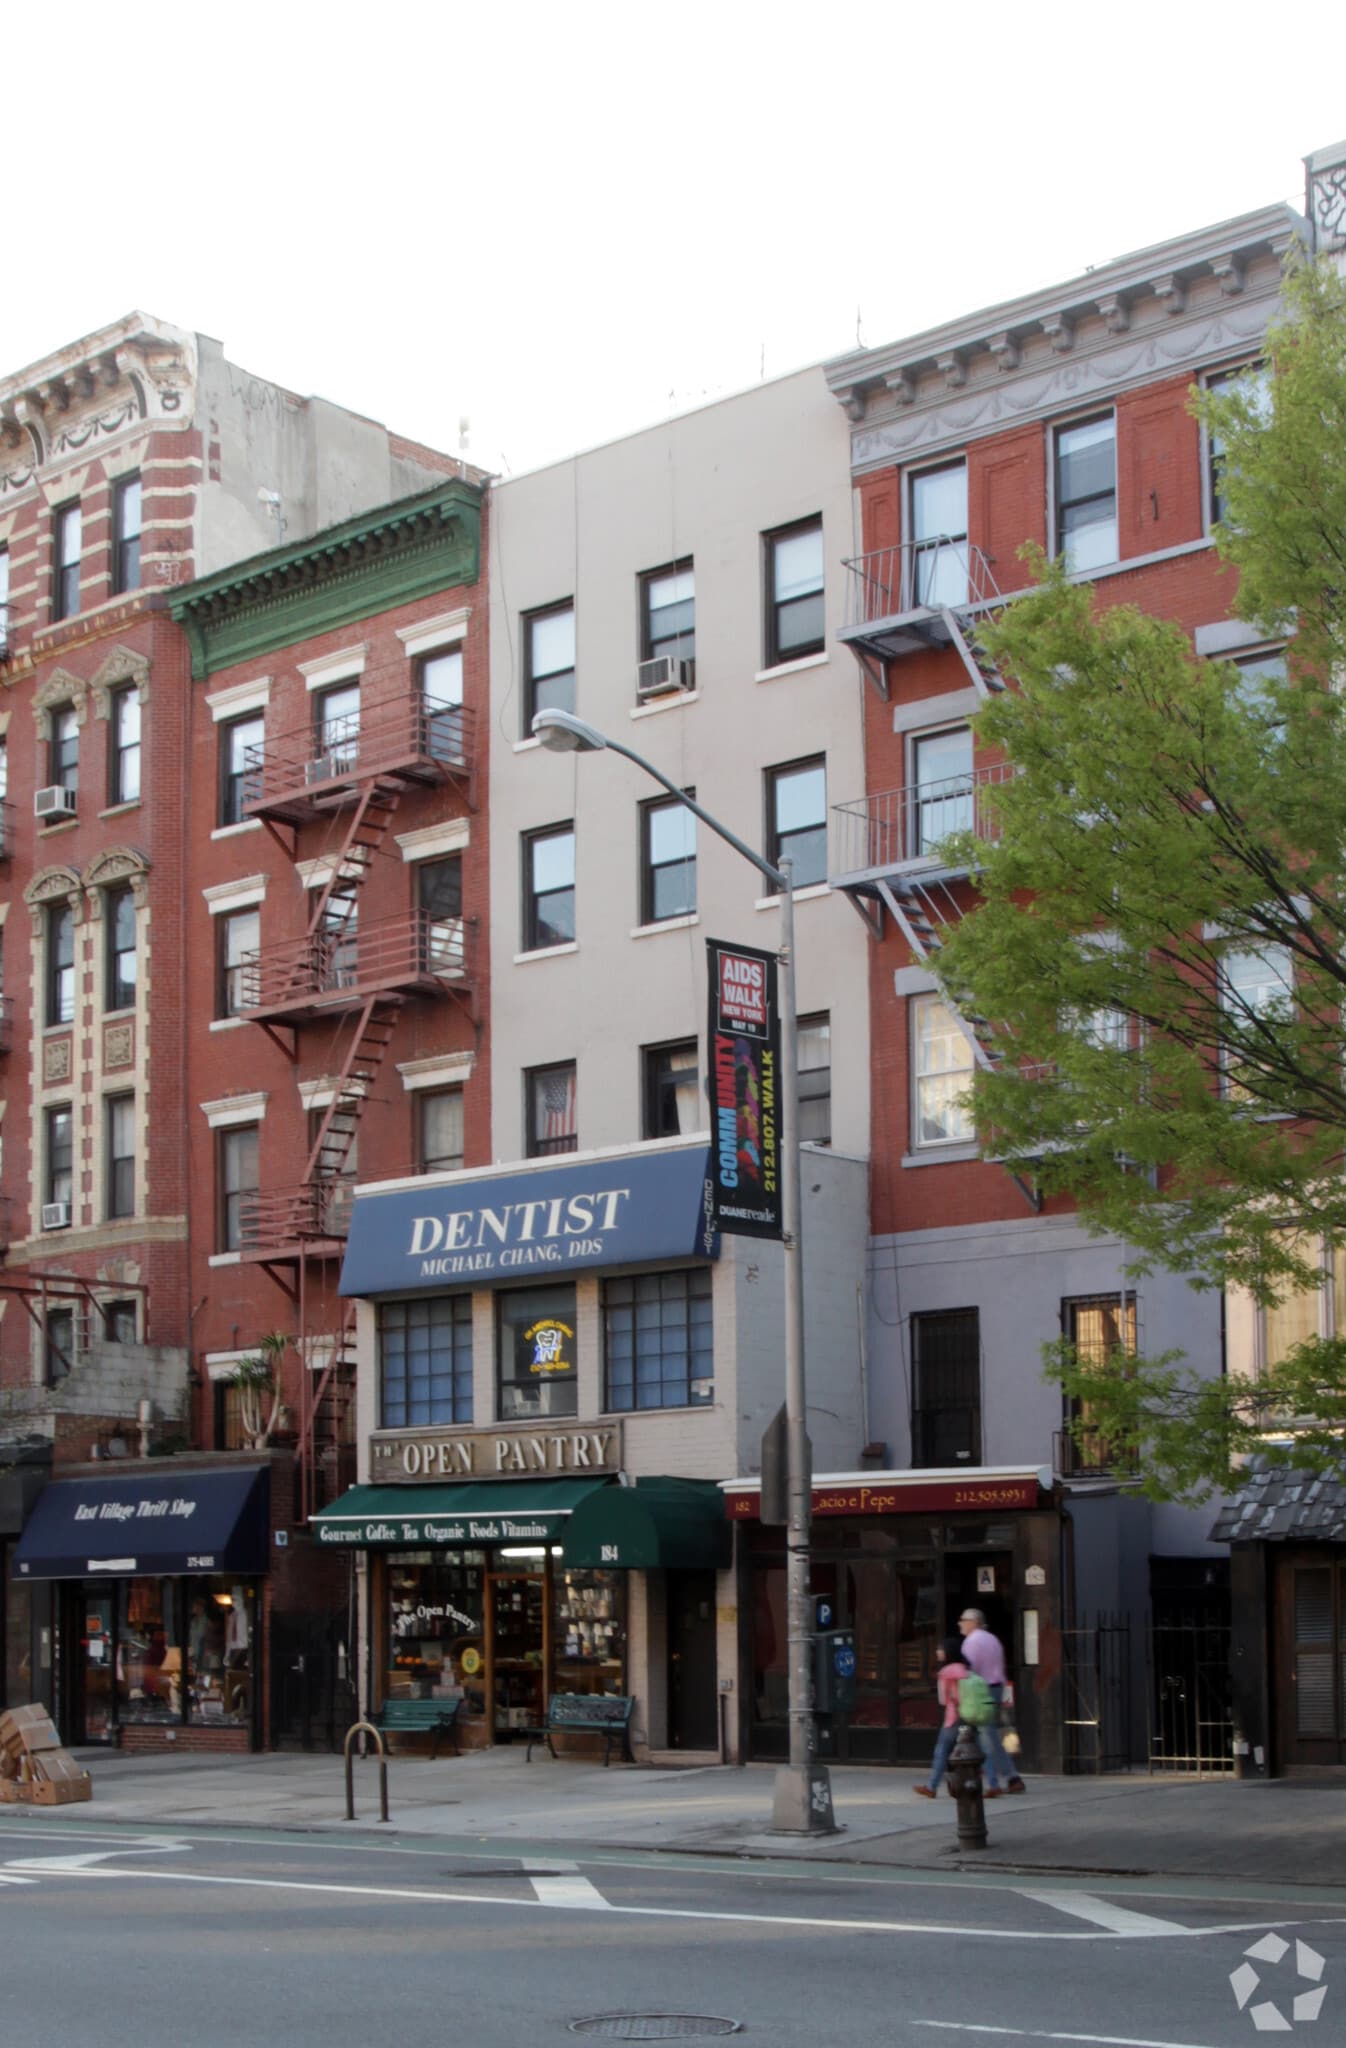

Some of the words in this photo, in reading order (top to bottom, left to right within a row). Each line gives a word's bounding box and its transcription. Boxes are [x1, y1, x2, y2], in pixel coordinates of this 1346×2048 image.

[723, 958, 762, 988] AIDS
[723, 983, 763, 1009] WALK
[721, 1003, 741, 1016] NEW
[742, 1007, 764, 1021] YORK
[714, 1032, 738, 1190] COMMUNITY
[407, 1189, 631, 1256] DENTIST
[420, 1251, 494, 1277] MICHAEL
[500, 1244, 563, 1267] CHANG,
[568, 1238, 604, 1258] DDS
[403, 1442, 473, 1475] OPEN
[495, 1432, 612, 1472] PANTRY
[74, 1504, 98, 1520] East
[99, 1502, 135, 1522] Village
[136, 1500, 169, 1518] Thrift
[169, 1499, 196, 1519] Shop
[849, 1498, 858, 1508] e
[860, 1488, 896, 1513] Pepe
[320, 1526, 362, 1541] Gourmet
[366, 1523, 396, 1540] Coffee
[401, 1523, 419, 1540] Tea
[424, 1522, 464, 1542] Organic
[469, 1521, 499, 1539] Foods
[501, 1520, 549, 1538] Vitamins
[601, 1545, 619, 1561] 184
[417, 1605, 444, 1621] Open
[445, 1603, 477, 1631] Pantry
[820, 1604, 831, 1624] P
